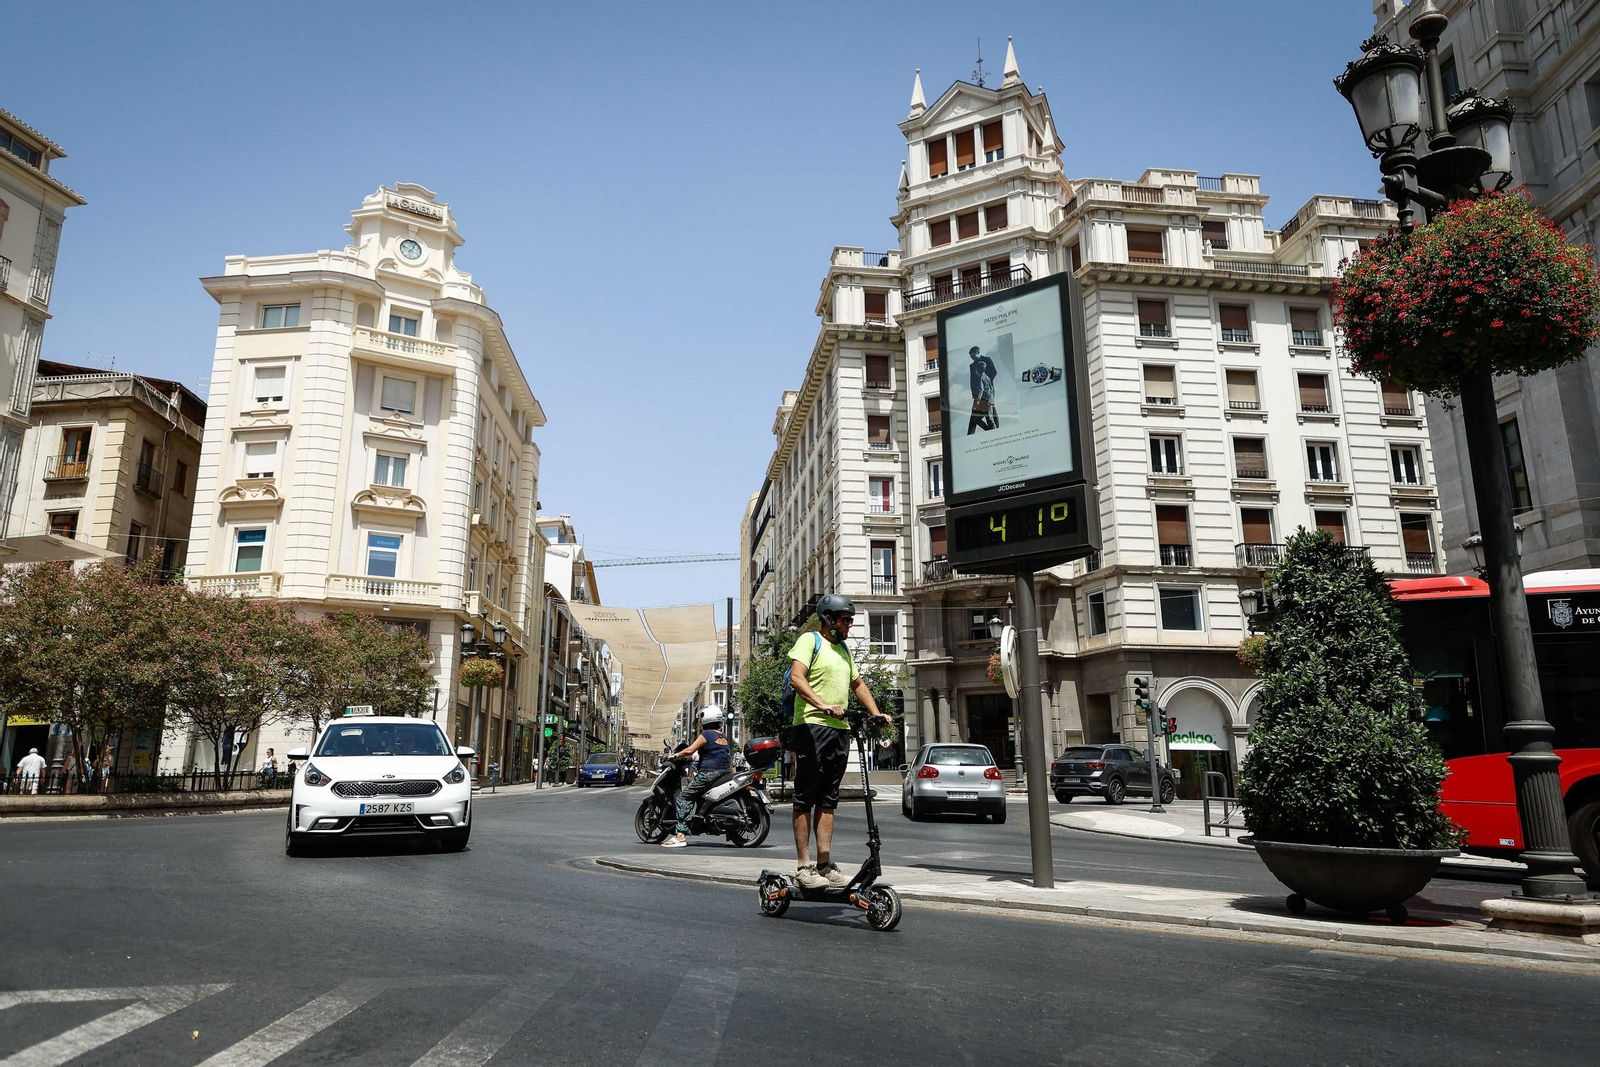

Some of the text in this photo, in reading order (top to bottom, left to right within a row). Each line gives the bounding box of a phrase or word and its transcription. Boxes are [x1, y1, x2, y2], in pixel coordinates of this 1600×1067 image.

[998, 482, 1026, 492] JCDecaux
[366, 803, 412, 814] 2587 KZS
